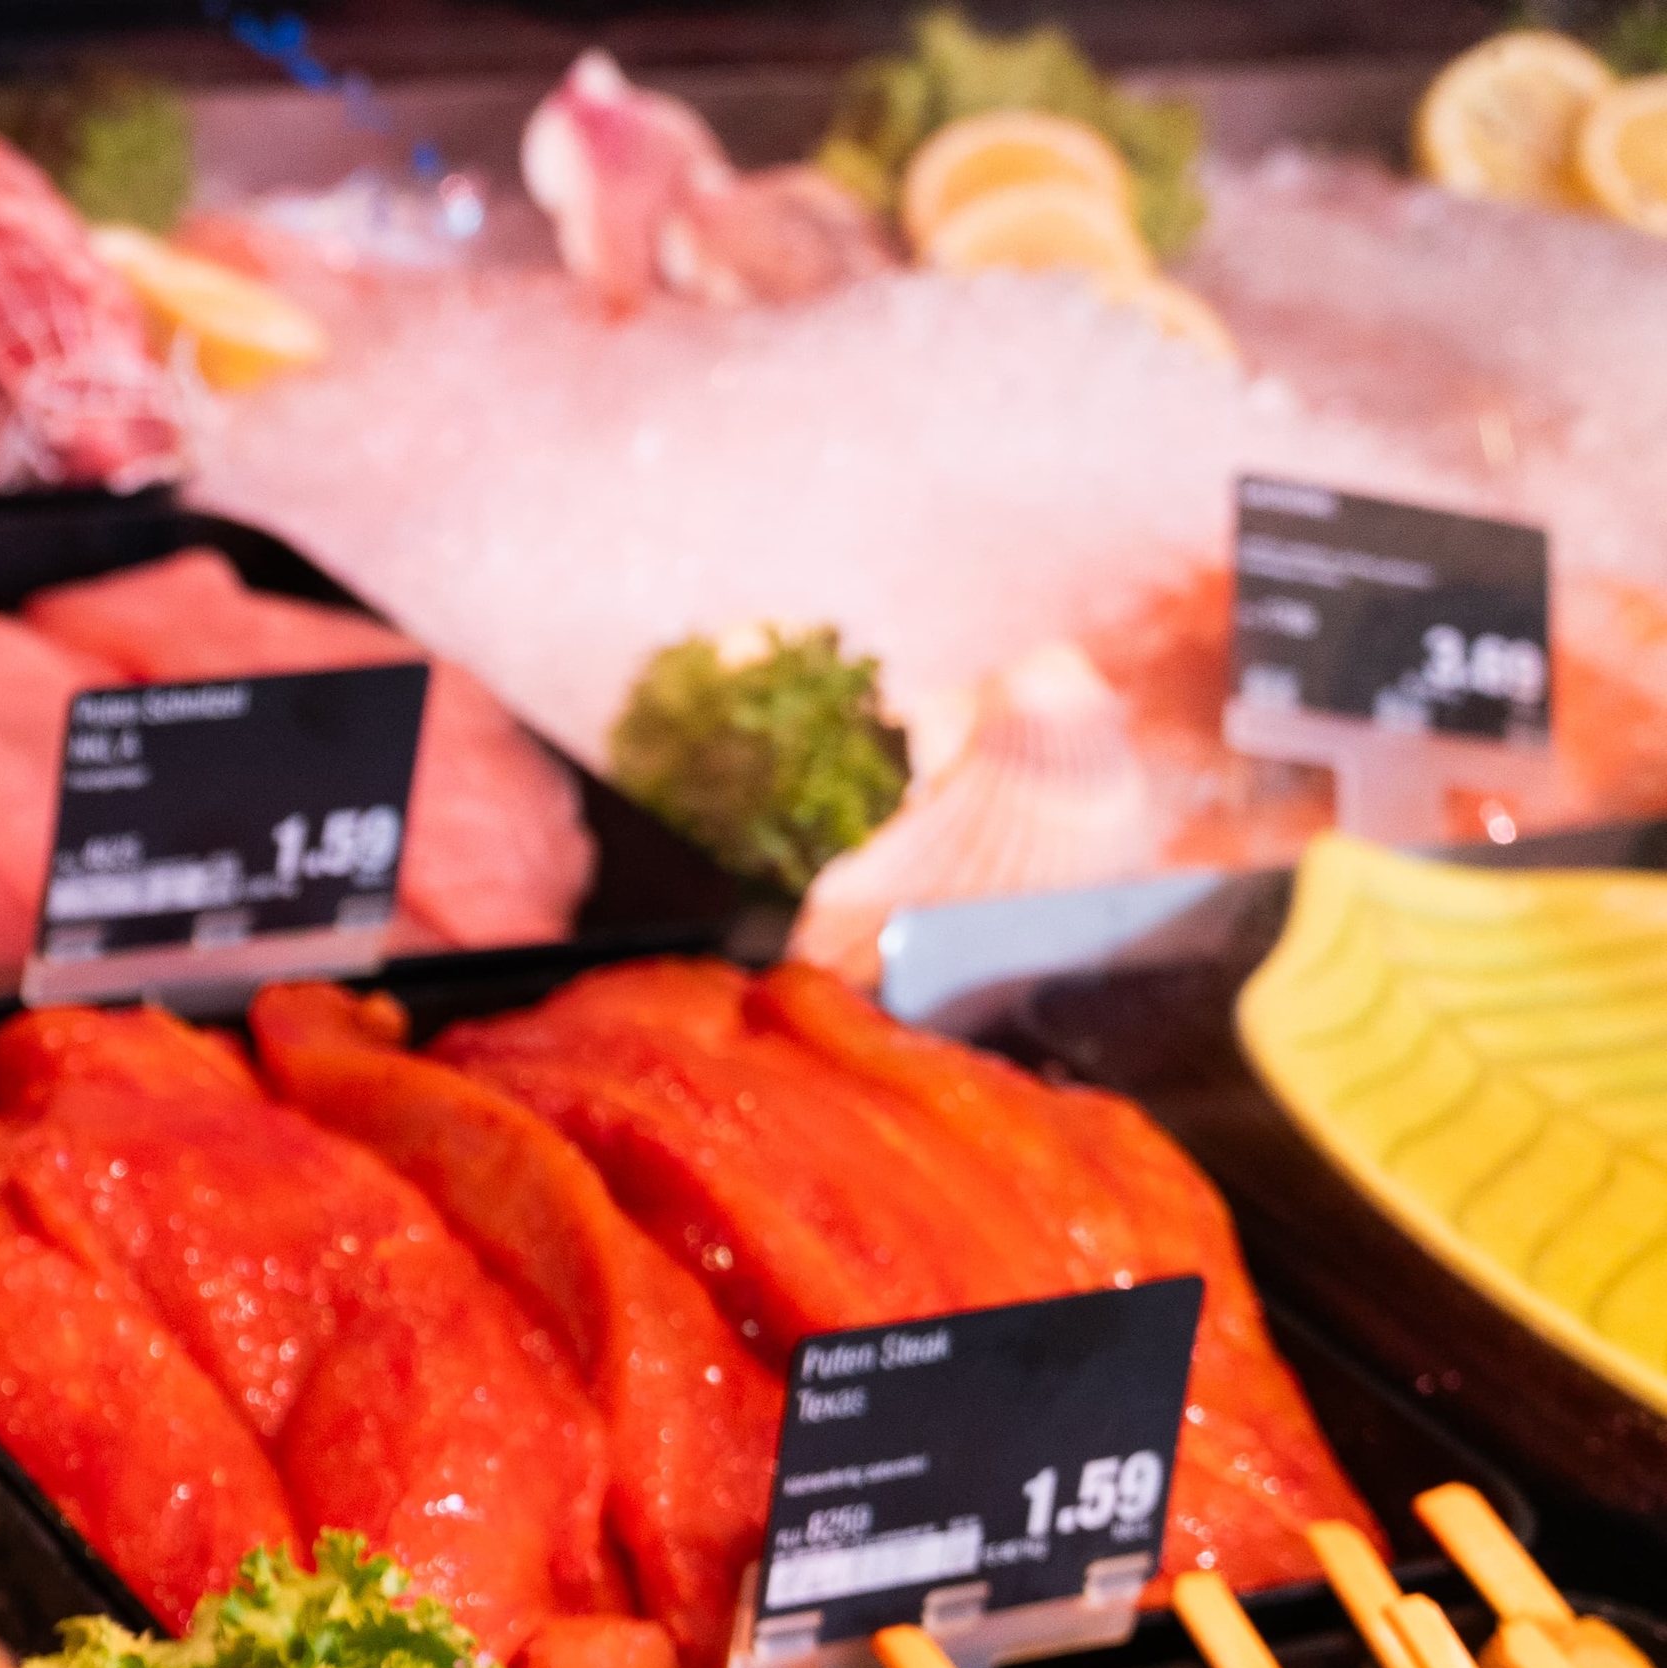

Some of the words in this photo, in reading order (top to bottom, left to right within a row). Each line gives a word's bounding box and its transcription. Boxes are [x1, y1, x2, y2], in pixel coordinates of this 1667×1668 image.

[271, 804, 404, 880] 1.59
[801, 1343, 878, 1382] Puten
[879, 1325, 953, 1371] Steak
[1022, 1450, 1164, 1536] 1.59
